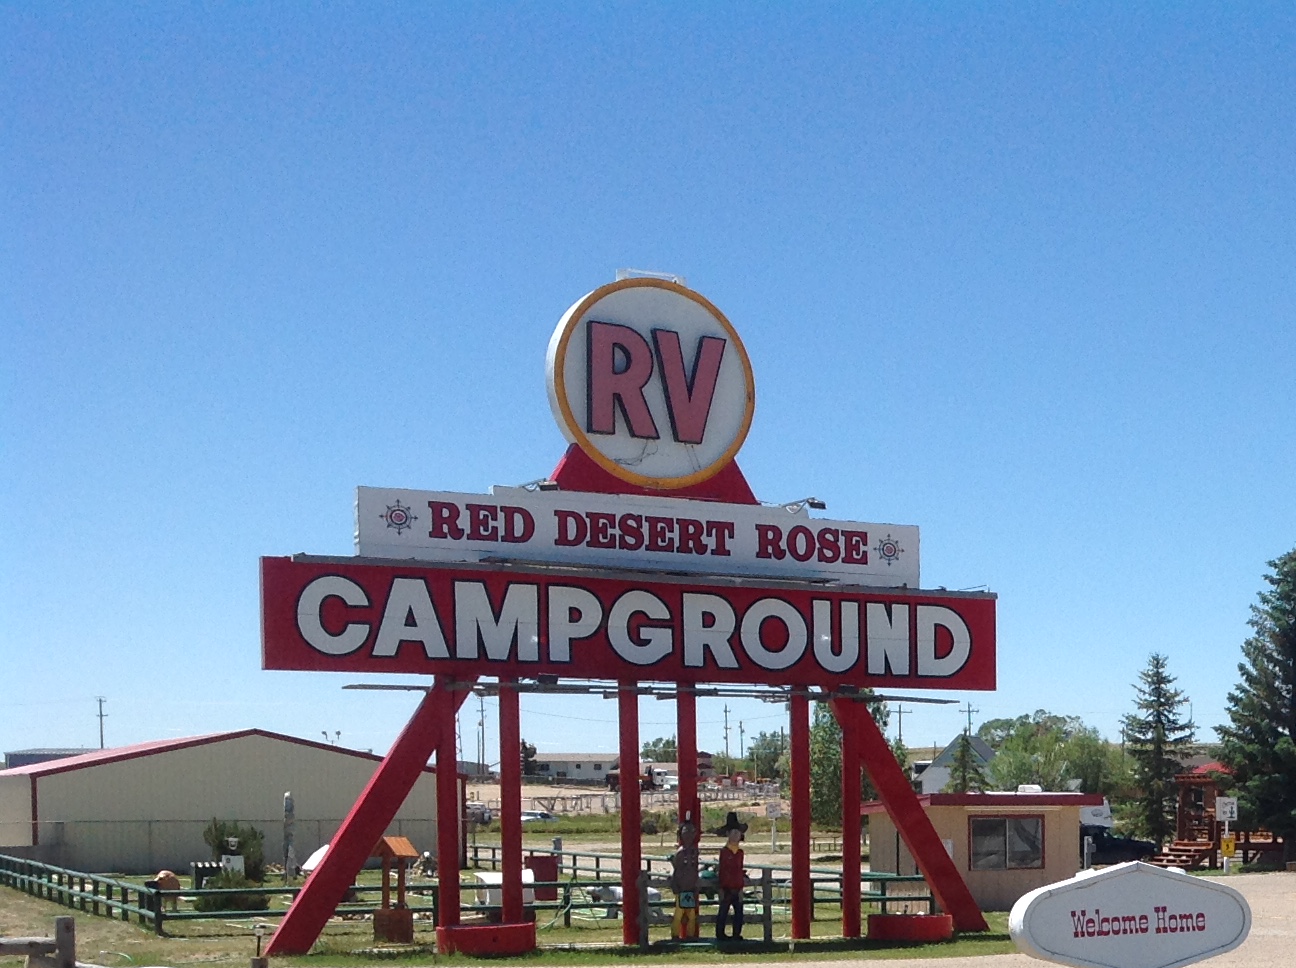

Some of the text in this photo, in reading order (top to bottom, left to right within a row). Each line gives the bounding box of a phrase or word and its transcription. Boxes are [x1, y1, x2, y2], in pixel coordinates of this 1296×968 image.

[585, 320, 728, 445] RV
[428, 500, 869, 567] RED DESERT ROSE
[296, 574, 972, 679] CAMPGROUND
[1070, 906, 1206, 938] Welcome Home
